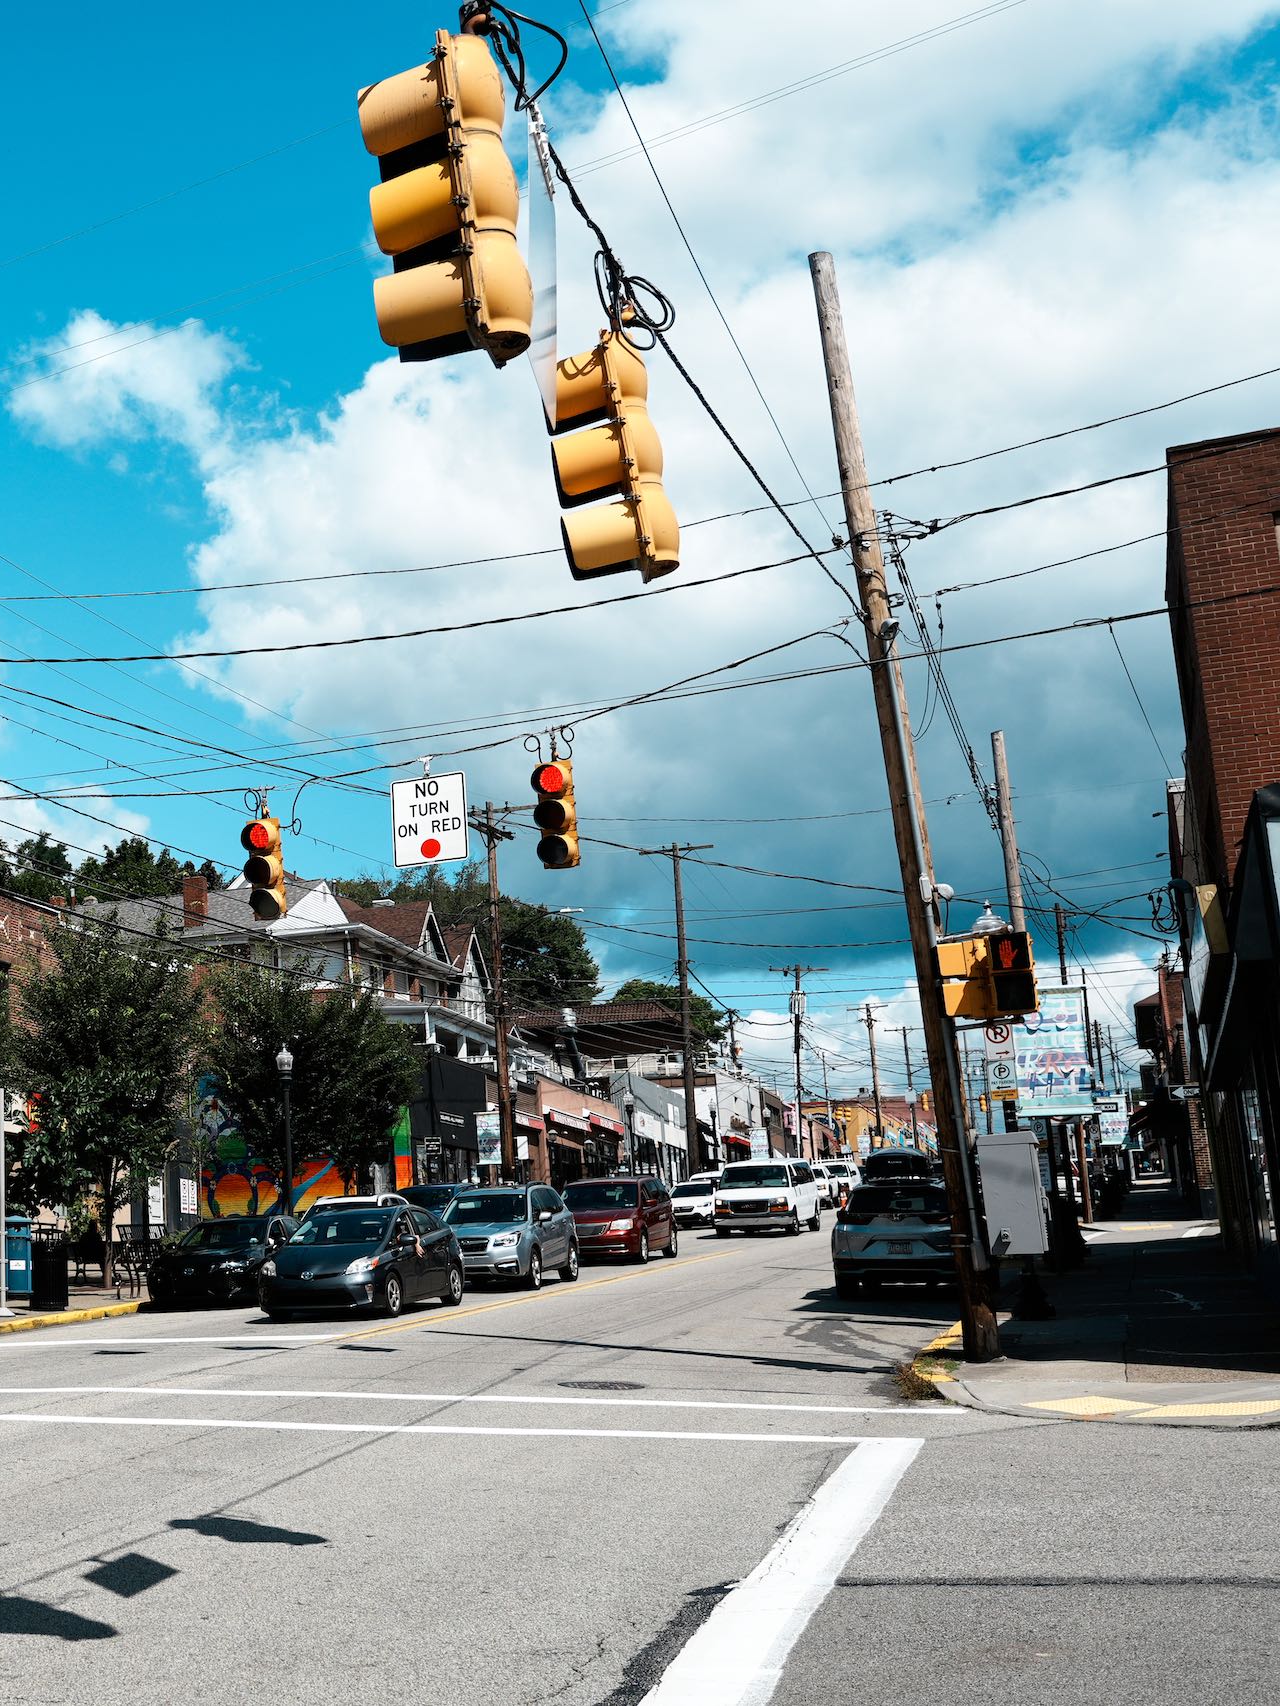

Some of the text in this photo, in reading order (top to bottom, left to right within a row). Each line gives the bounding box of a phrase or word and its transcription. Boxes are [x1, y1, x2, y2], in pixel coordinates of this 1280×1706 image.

[415, 780, 439, 799] NO
[409, 800, 449, 817] TURN
[398, 816, 461, 838] ON RED
